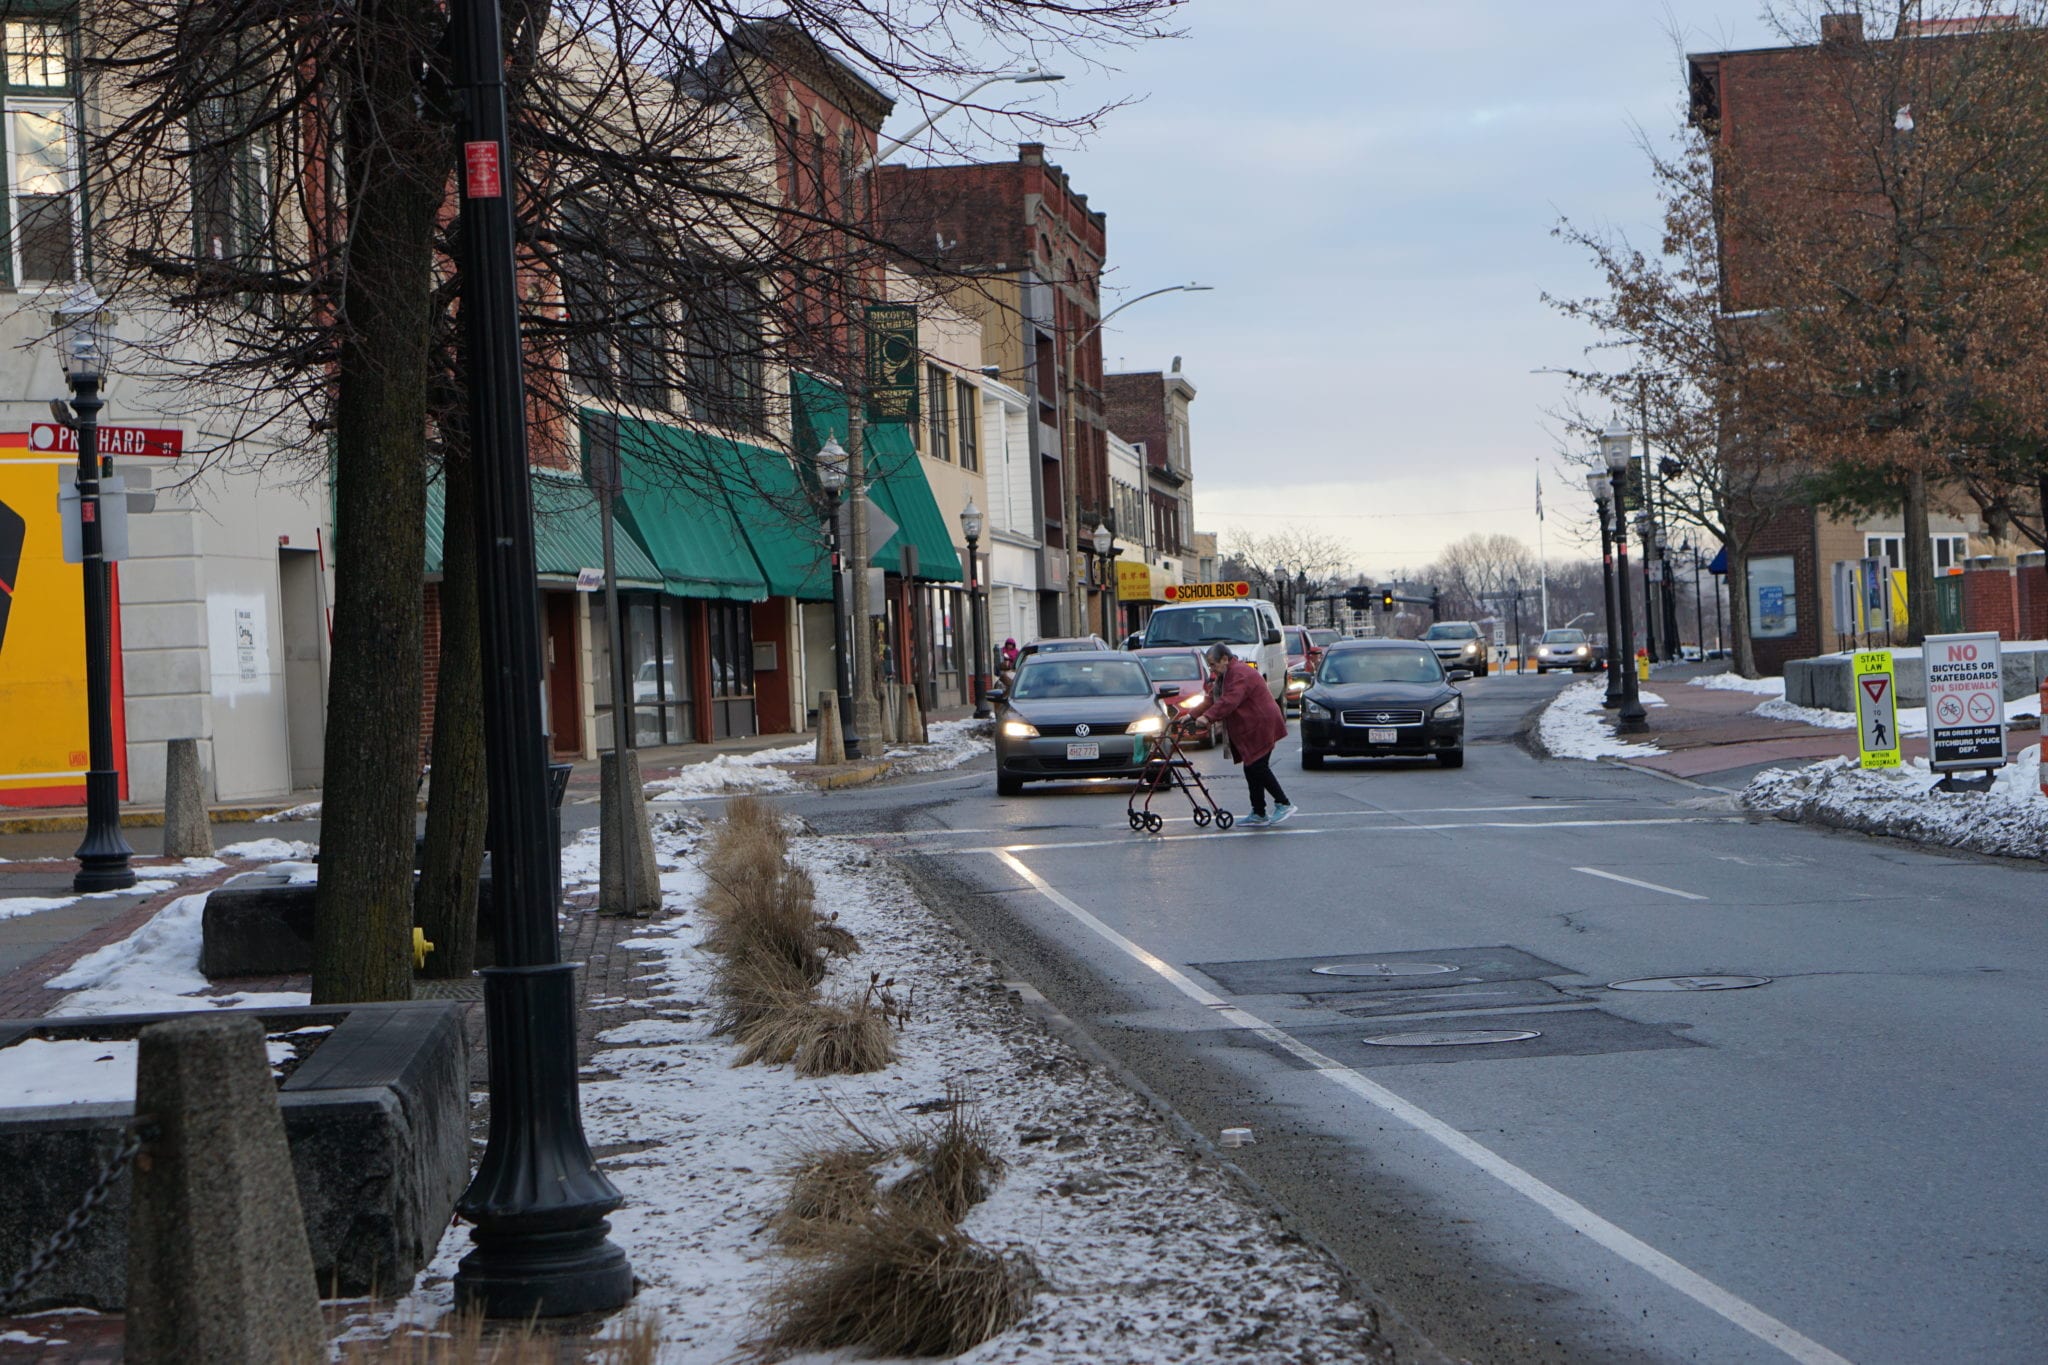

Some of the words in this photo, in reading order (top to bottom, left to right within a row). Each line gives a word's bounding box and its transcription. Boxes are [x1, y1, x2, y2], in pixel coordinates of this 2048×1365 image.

[1178, 584, 1214, 599] SCHOOL
[1216, 583, 1235, 597] BUS
[1495, 631, 1504, 639] 12
[1947, 644, 1977, 662] NO
[1860, 654, 1886, 663] STATE
[1865, 664, 1883, 672] LAW
[1932, 663, 1978, 673] BICYCLES
[1981, 662, 1994, 670] OR
[1930, 671, 1998, 682] SKATEBOARDS
[1931, 684, 1945, 693] ON
[1948, 681, 1998, 692] SIDEWALK
[1952, 729, 1973, 737] ORDER
[1984, 727, 1996, 735] THE
[1935, 739, 1974, 748] FITCHBURG
[1865, 759, 1897, 767] CROSSWALK
